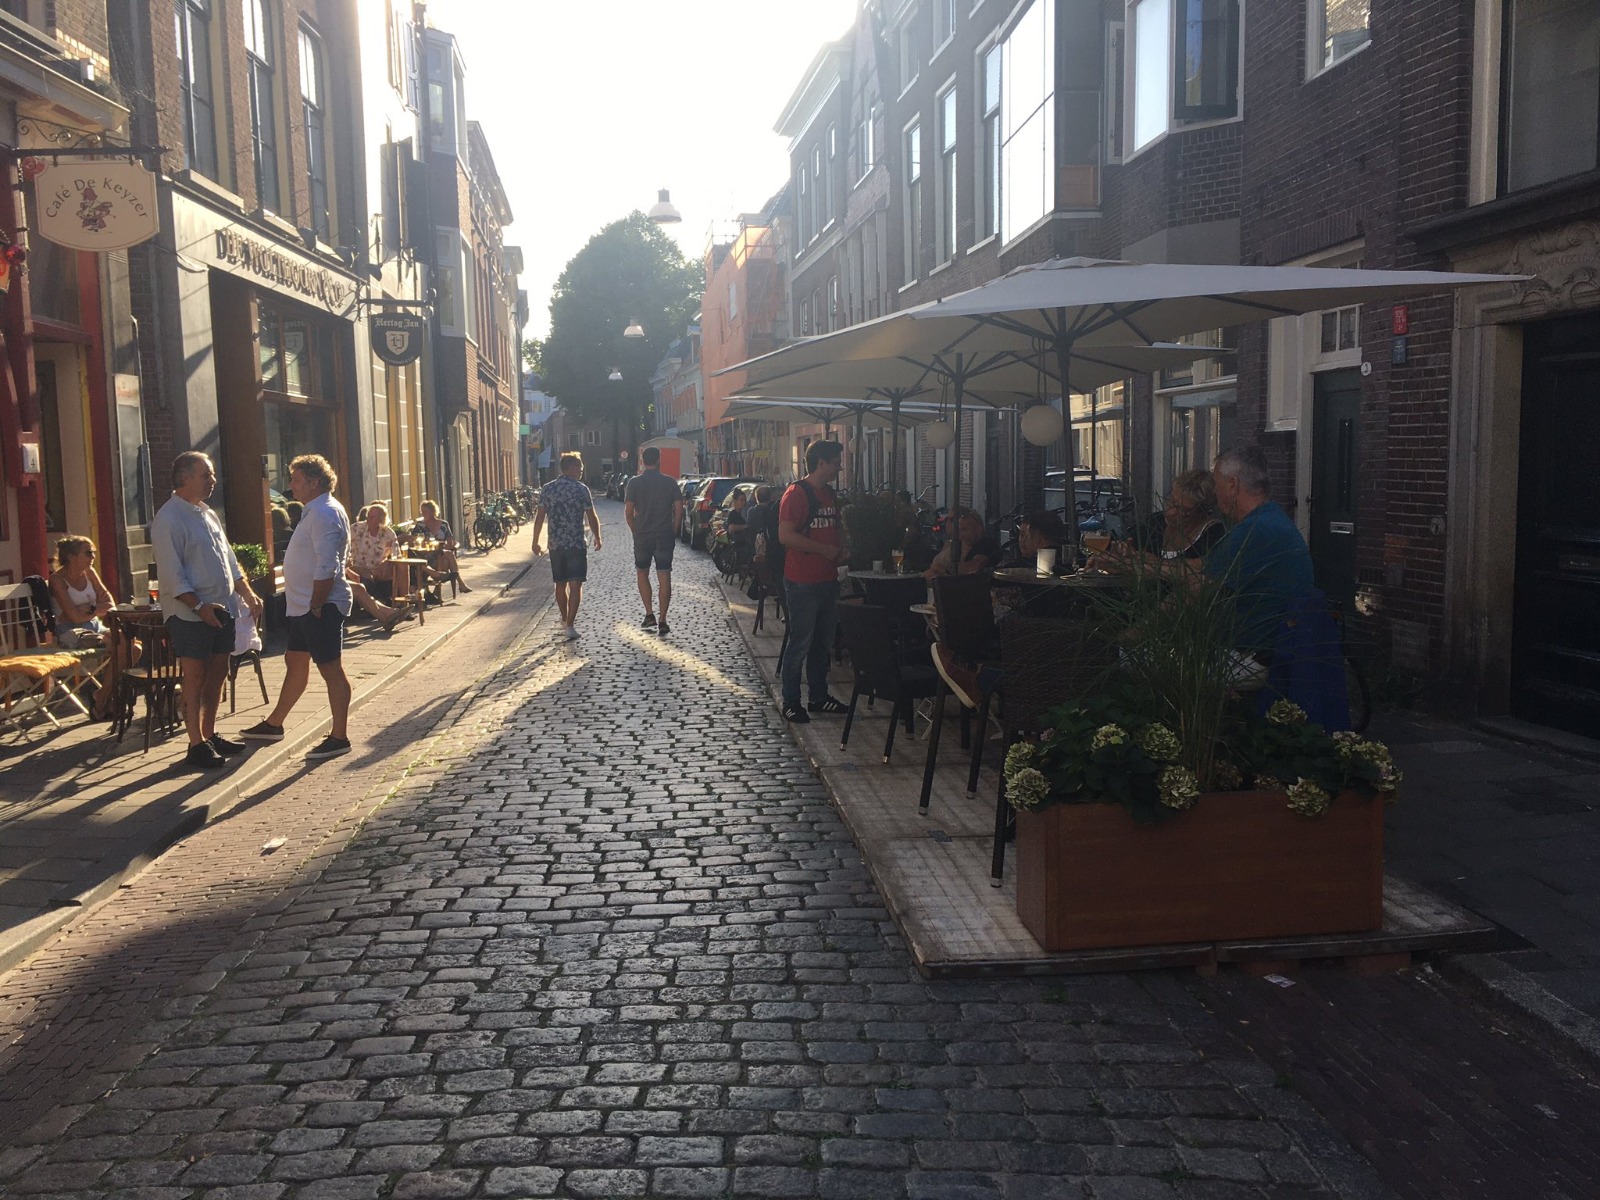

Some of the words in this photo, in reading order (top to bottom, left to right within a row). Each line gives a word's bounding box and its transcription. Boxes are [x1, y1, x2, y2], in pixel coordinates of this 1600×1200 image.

[45, 185, 72, 218] Café
[73, 178, 96, 192] De
[102, 177, 149, 219] Keyzer
[374, 317, 403, 329] Hertog
[403, 318, 420, 329] Jan
[30, 457, 36, 469] 4
